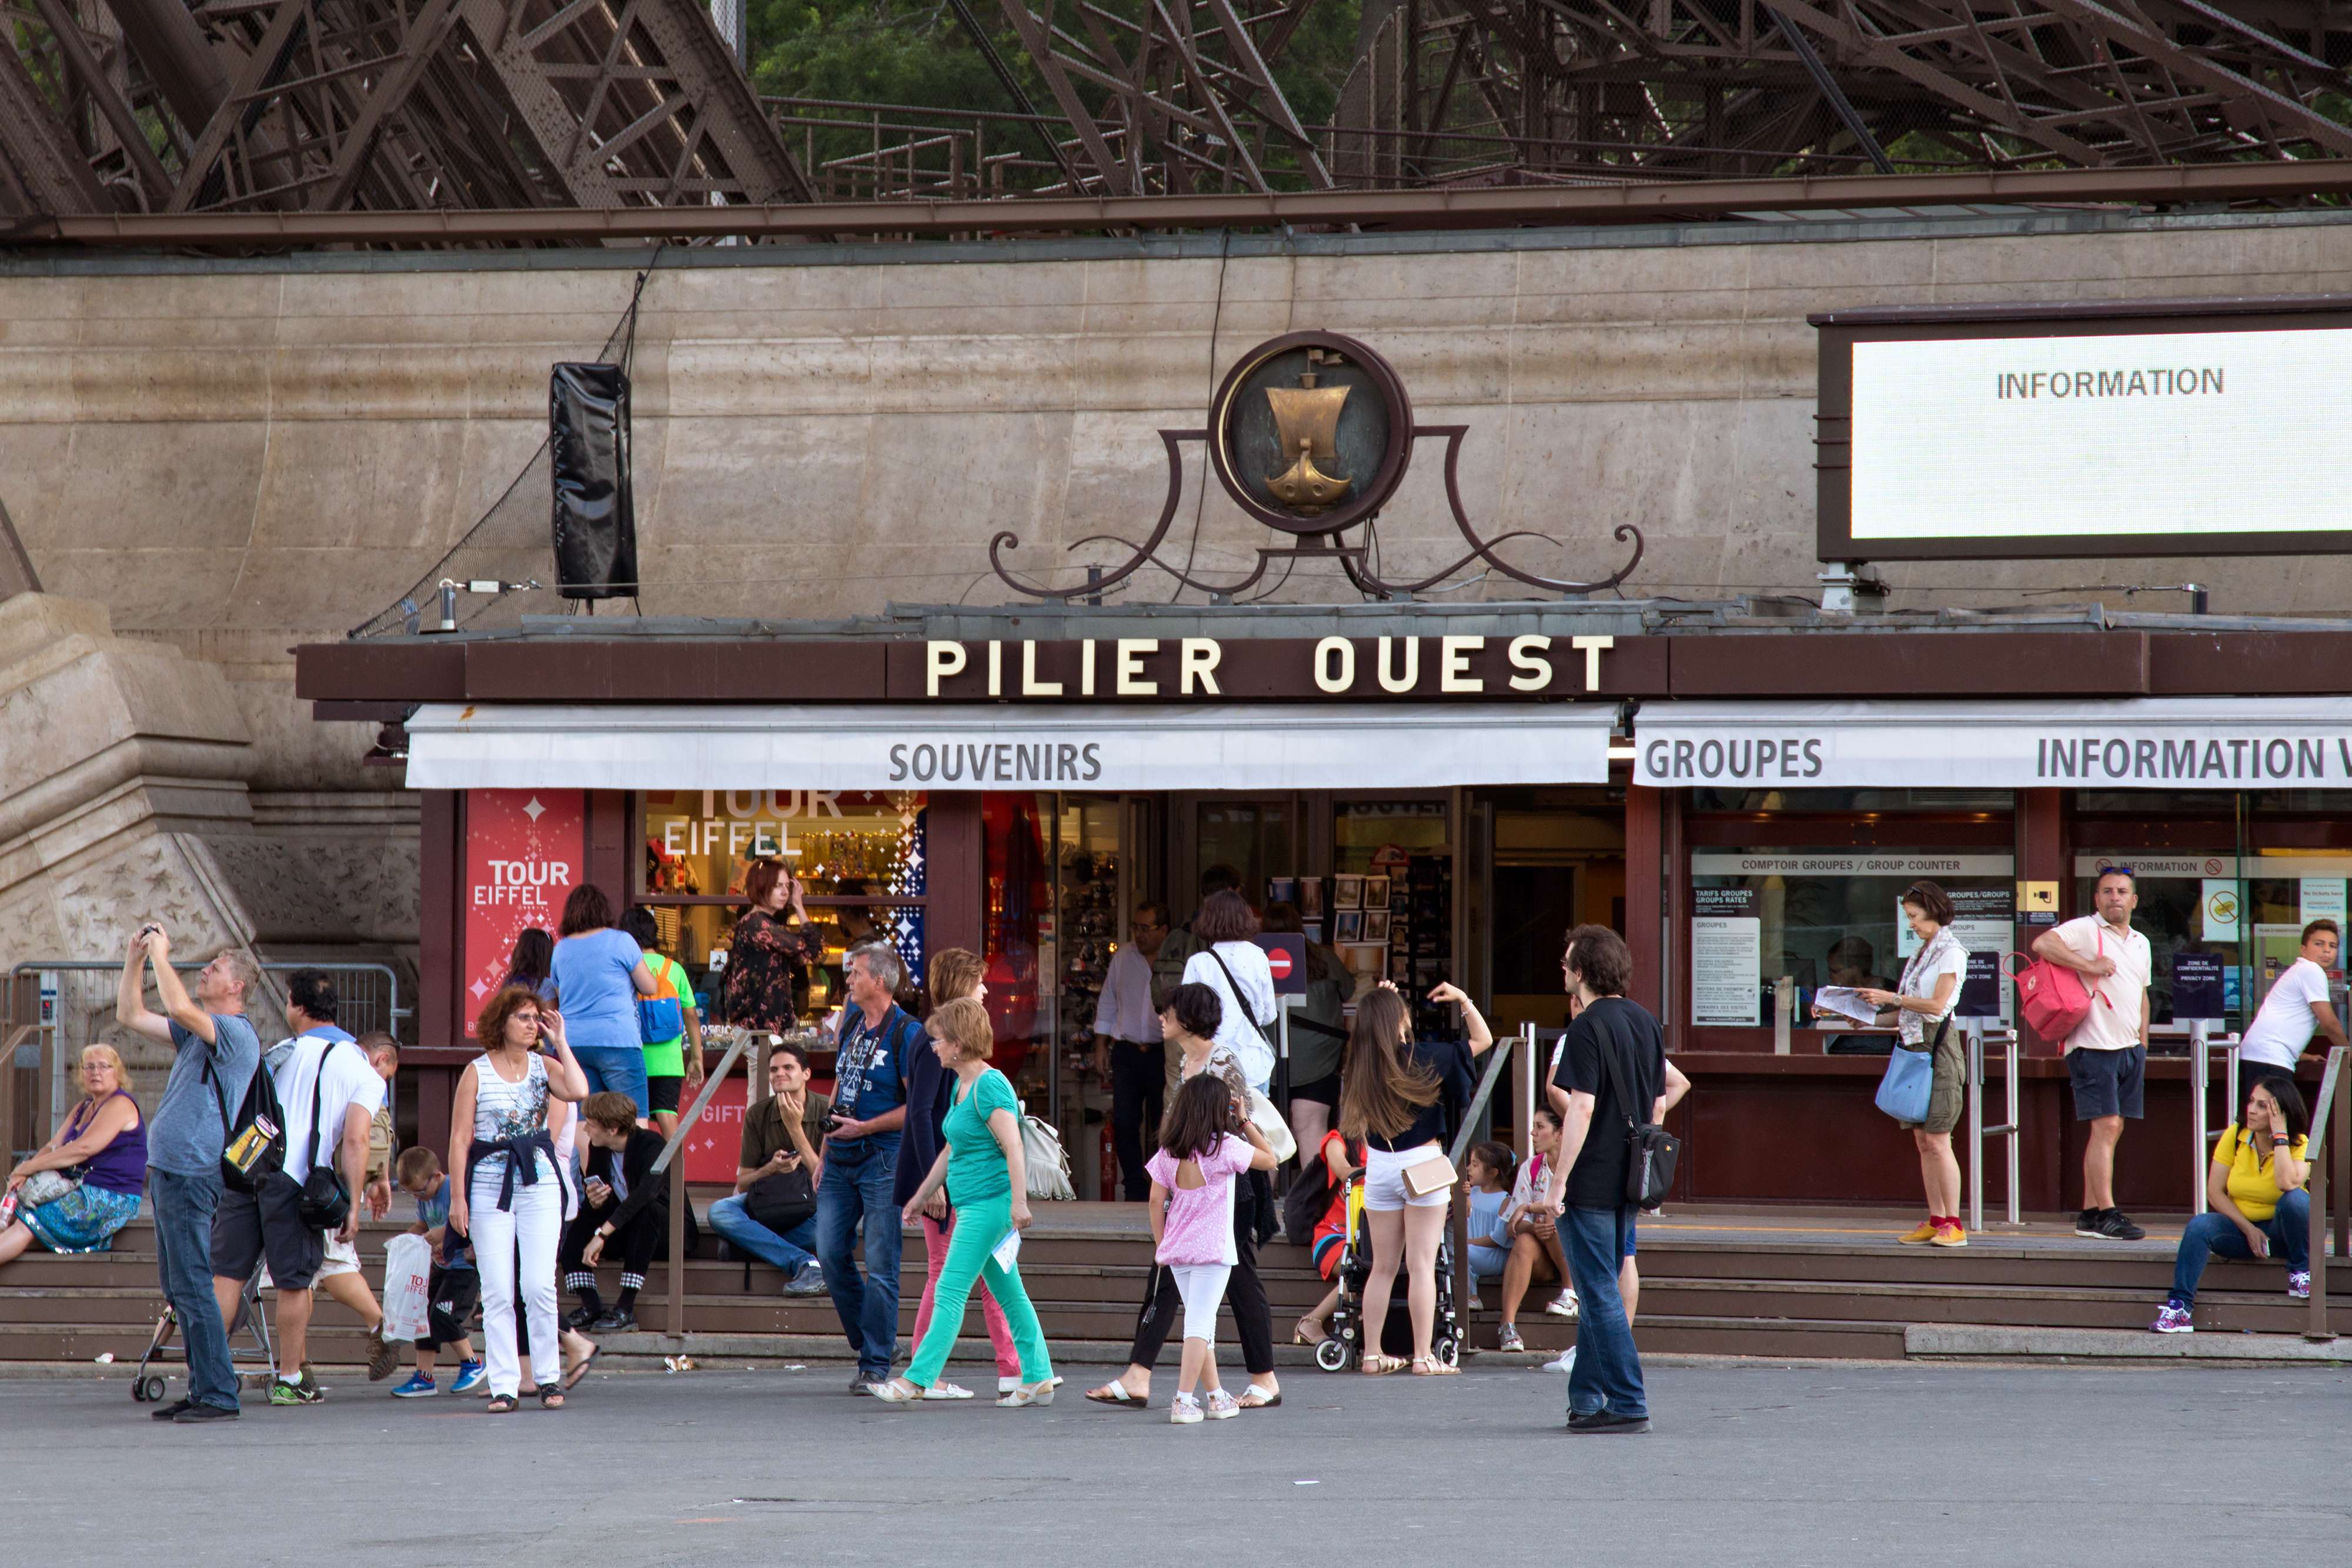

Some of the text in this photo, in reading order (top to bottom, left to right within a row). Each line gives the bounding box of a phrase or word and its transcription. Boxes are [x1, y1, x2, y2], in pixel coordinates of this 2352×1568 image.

[1997, 367, 2226, 400] INFORMATION
[927, 634, 1615, 697] PILIER OUEST
[888, 742, 1102, 783] SOUVENIRS
[1645, 737, 1823, 780] GROUPES
[2037, 738, 2324, 779] INFORMATION
[664, 821, 803, 855] EIFFEL
[488, 860, 569, 886] TOUR
[1742, 860, 1798, 870] COMPTOIR
[1802, 860, 1853, 870] GROUPES
[1867, 860, 1905, 870] GROUP
[1908, 860, 1960, 870] COUNTER
[2120, 861, 2197, 872] INFORMATION
[474, 885, 548, 905] EIFFEL
[863, 1079, 873, 1092] 76
